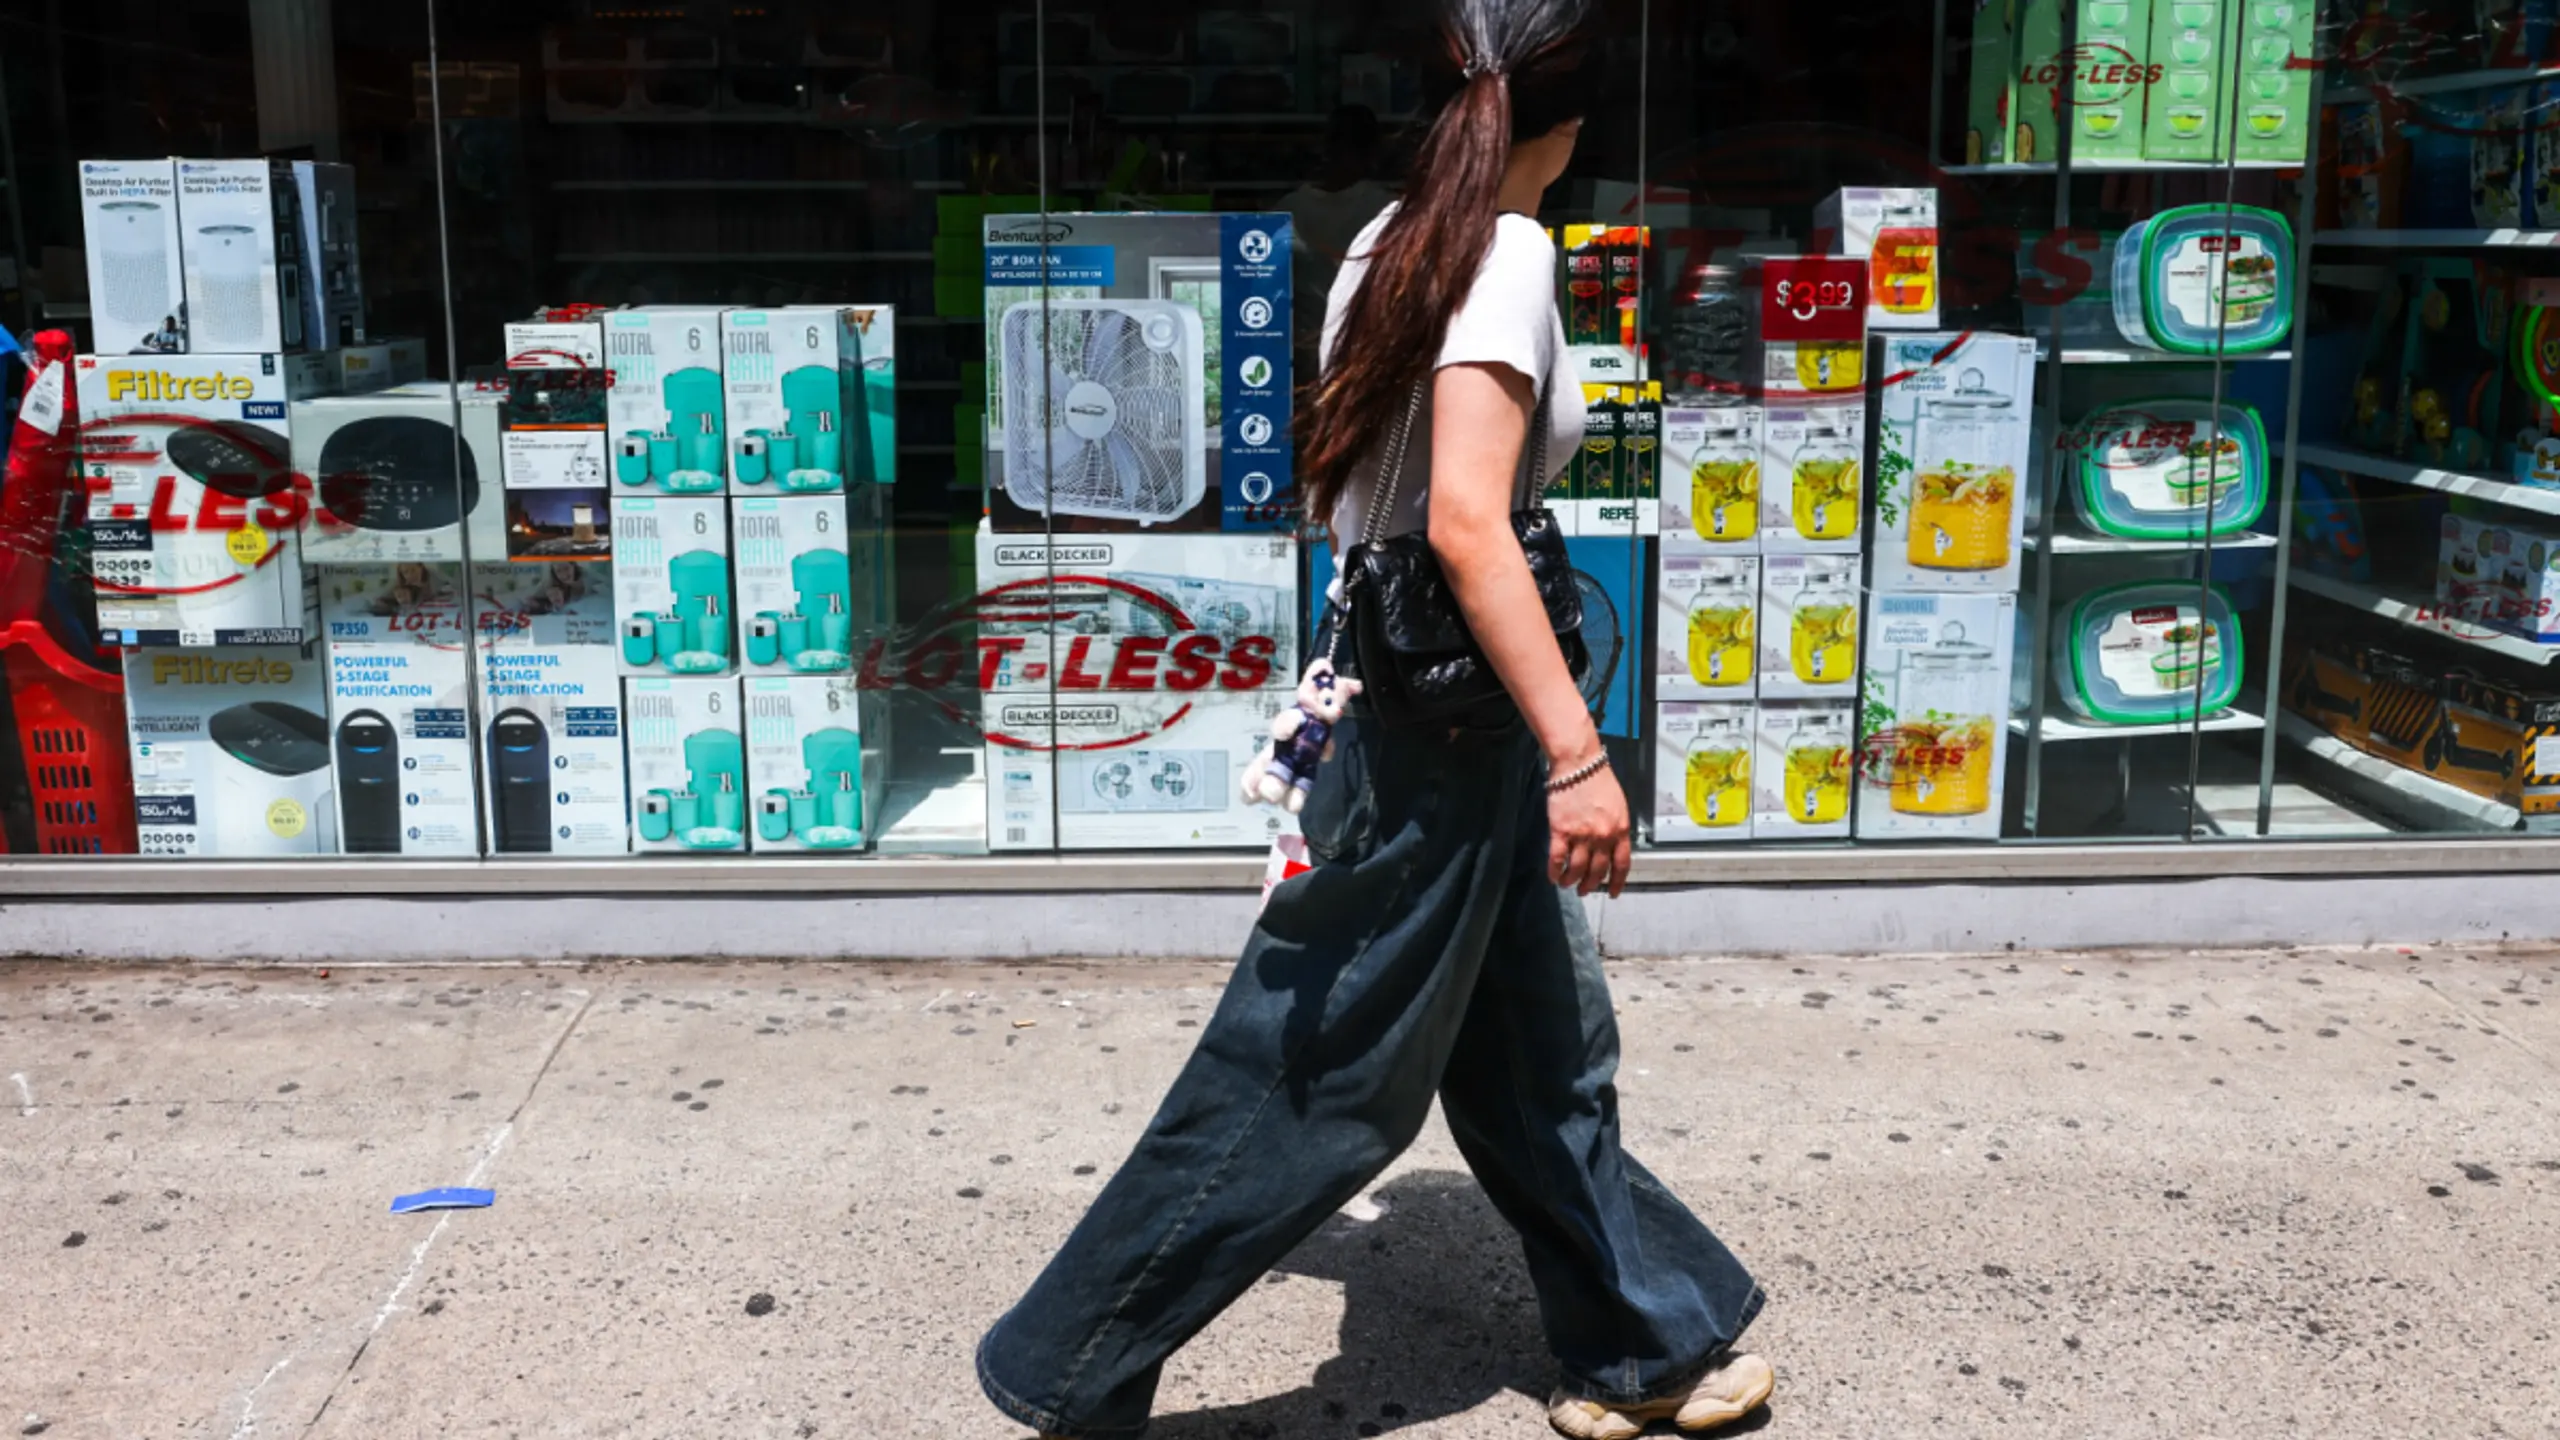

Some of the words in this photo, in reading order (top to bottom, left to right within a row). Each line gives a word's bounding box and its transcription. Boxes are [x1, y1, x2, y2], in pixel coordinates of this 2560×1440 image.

[2020, 64, 2164, 84] LOT-LESS
[989, 229, 1065, 243] Brentwod
[1568, 256, 1601, 267] REPEL
[1613, 256, 1641, 267] REP
[1620, 226, 2103, 308] T-LESS
[610, 332, 655, 356] TOTAL
[687, 327, 701, 351] 6
[729, 331, 774, 355] TOTAL
[806, 326, 819, 349] 6
[79, 359, 96, 369] 3M
[730, 354, 775, 381] BATH
[1590, 357, 1622, 368] REPEL
[107, 368, 255, 400] Filtrete
[247, 405, 279, 415] NEW!
[2056, 425, 2191, 450] LOT-LESS
[617, 516, 660, 539] TOTAL
[693, 512, 707, 534] 6
[740, 516, 783, 539] TOTAL
[815, 510, 828, 533] 6
[618, 539, 662, 566] BATH
[741, 539, 785, 566] BATH
[1000, 548, 1108, 562] BLACKDECKER
[2416, 597, 2552, 621] LOT-LESS
[331, 622, 368, 635] TP350
[153, 653, 293, 685] Filtrete
[334, 656, 408, 668] POWERFUL
[485, 655, 560, 667] POWERFUL
[857, 635, 1276, 690] LOT-LESS
[335, 670, 390, 682] 5-STAGE
[487, 669, 541, 682] 5-STAGE
[336, 684, 432, 697] PURIFICATION
[488, 683, 584, 696] PURIFICATION
[633, 695, 675, 718] TOTAL
[708, 691, 721, 713] 6
[752, 695, 795, 718] TOTAL
[131, 722, 201, 733] INTELLIGENT
[1831, 745, 1966, 768] LOT-LESS
